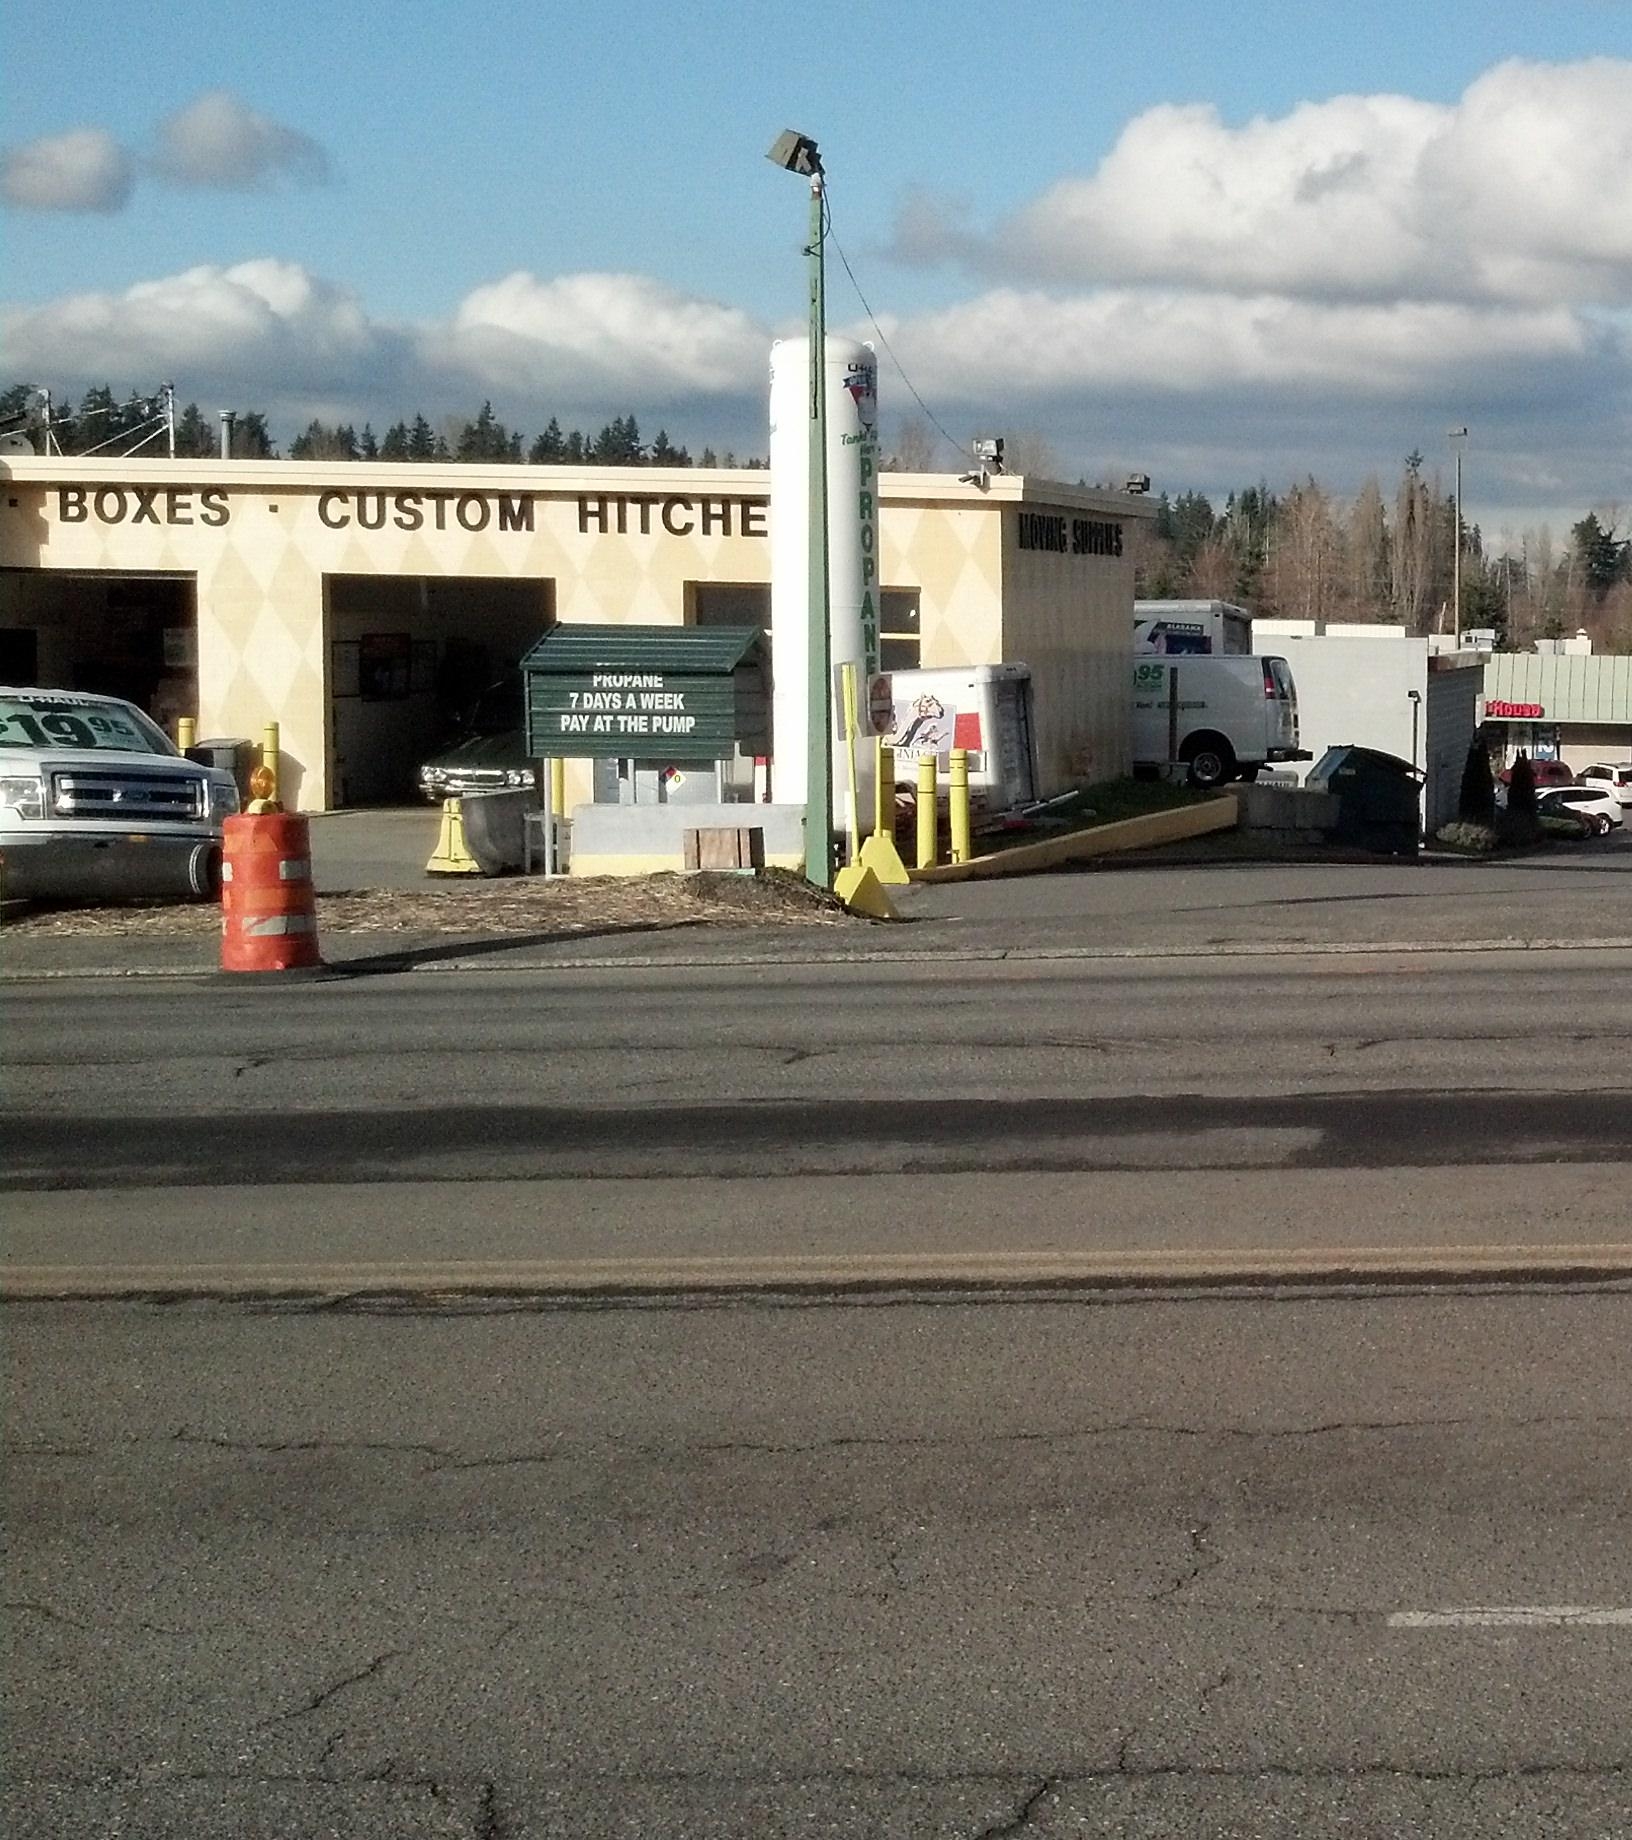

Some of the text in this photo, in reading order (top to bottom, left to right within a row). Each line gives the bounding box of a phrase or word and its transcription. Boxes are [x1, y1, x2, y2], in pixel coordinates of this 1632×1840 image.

[58, 486, 769, 538] BOXES CUSTOM HITCHE
[1018, 513, 1068, 554] MOVING
[860, 457, 876, 685] PROPANE
[593, 674, 663, 688] PROPANE
[1138, 664, 1164, 680] 95
[570, 693, 685, 710] 7 DAYS A WEEK
[87, 716, 135, 736] 95
[560, 715, 696, 733] PAY AT THE PUMP
